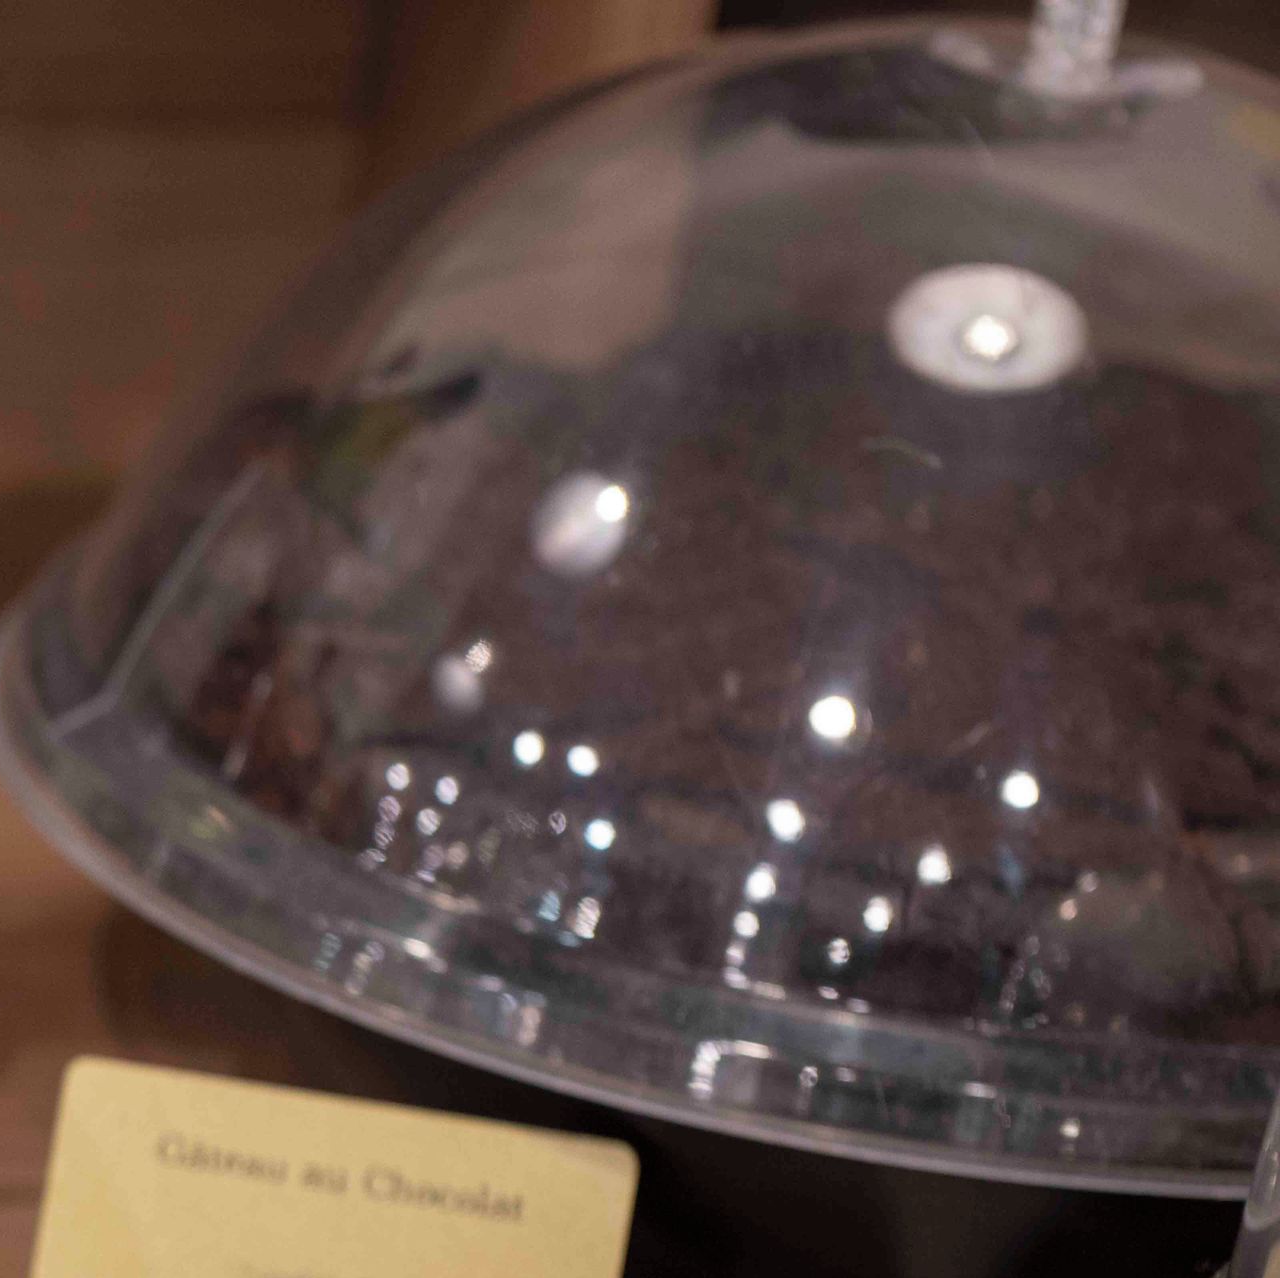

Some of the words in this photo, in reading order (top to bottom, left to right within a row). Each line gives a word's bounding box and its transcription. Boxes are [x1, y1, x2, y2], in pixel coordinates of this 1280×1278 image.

[154, 1132, 290, 1187] Gâteau
[301, 1162, 350, 1195] au
[361, 1162, 527, 1223] Chocolat
